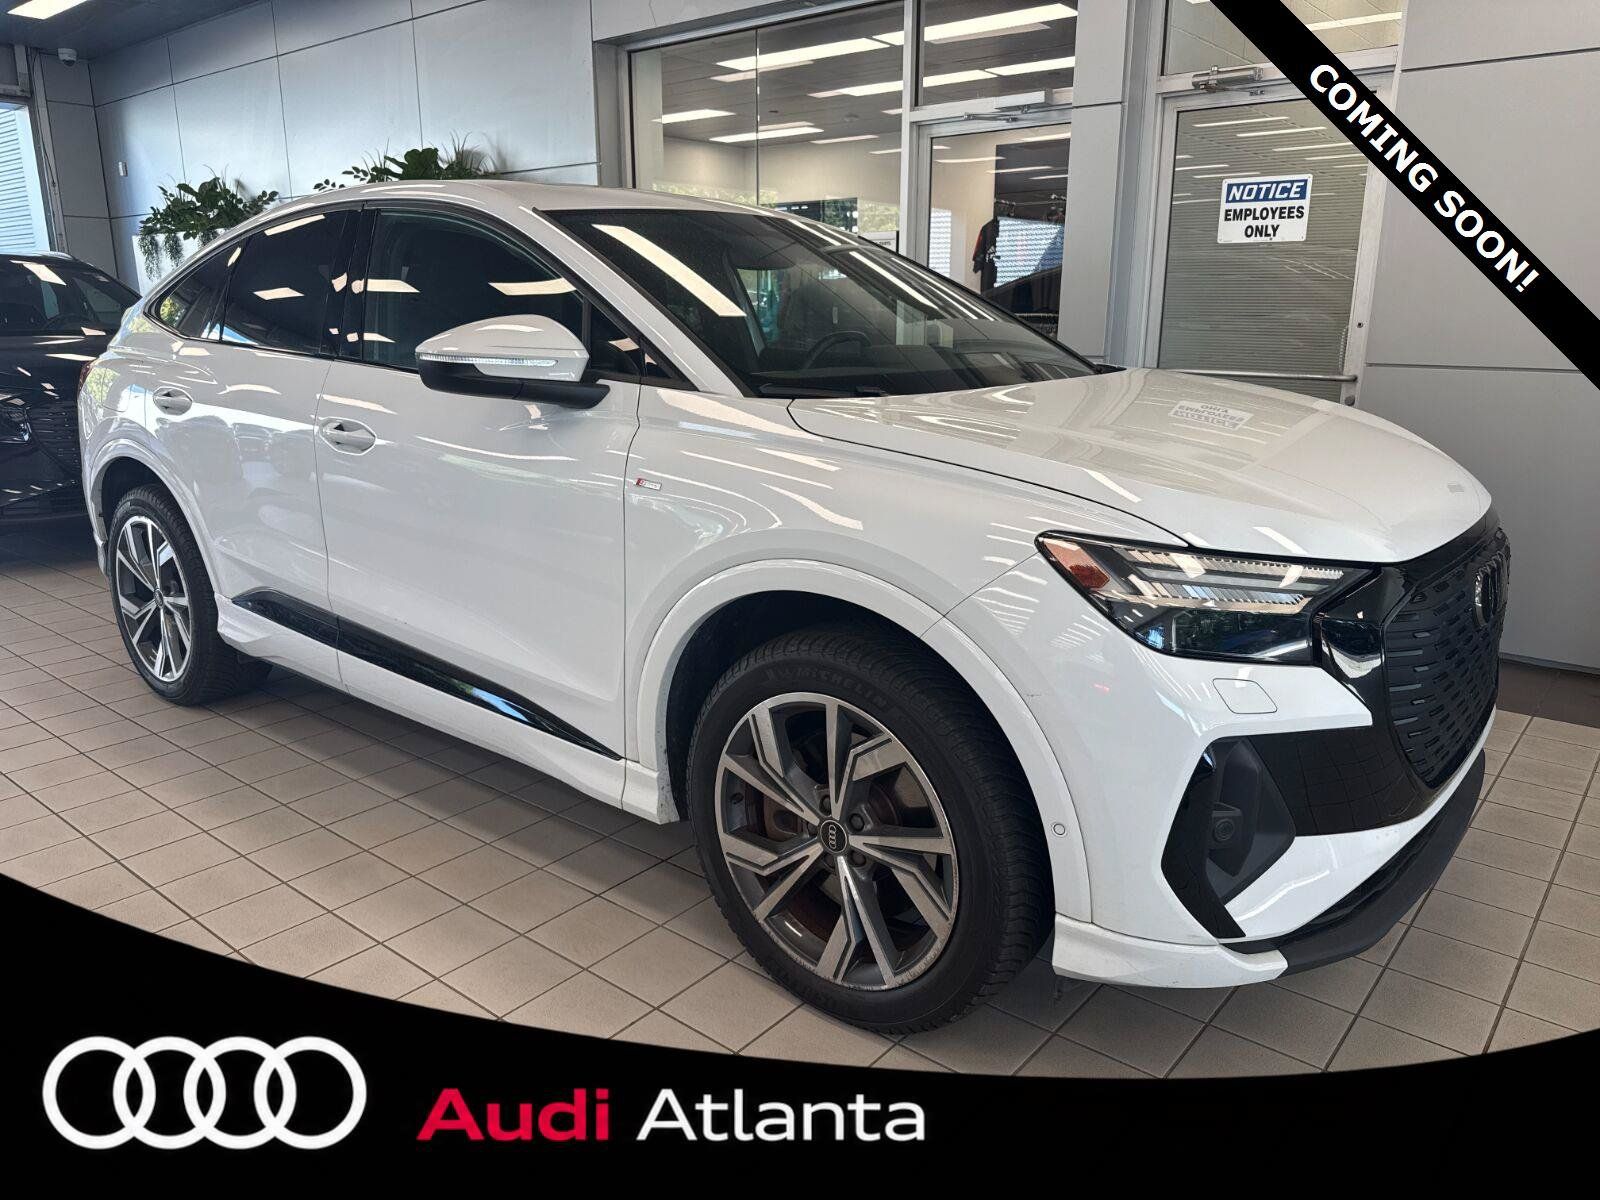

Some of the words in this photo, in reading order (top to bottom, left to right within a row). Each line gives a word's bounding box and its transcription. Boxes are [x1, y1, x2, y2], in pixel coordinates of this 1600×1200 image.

[1228, 181, 1305, 201] NOTICE
[1224, 205, 1305, 222] EMPLOYEES
[1244, 224, 1280, 238] ONLY
